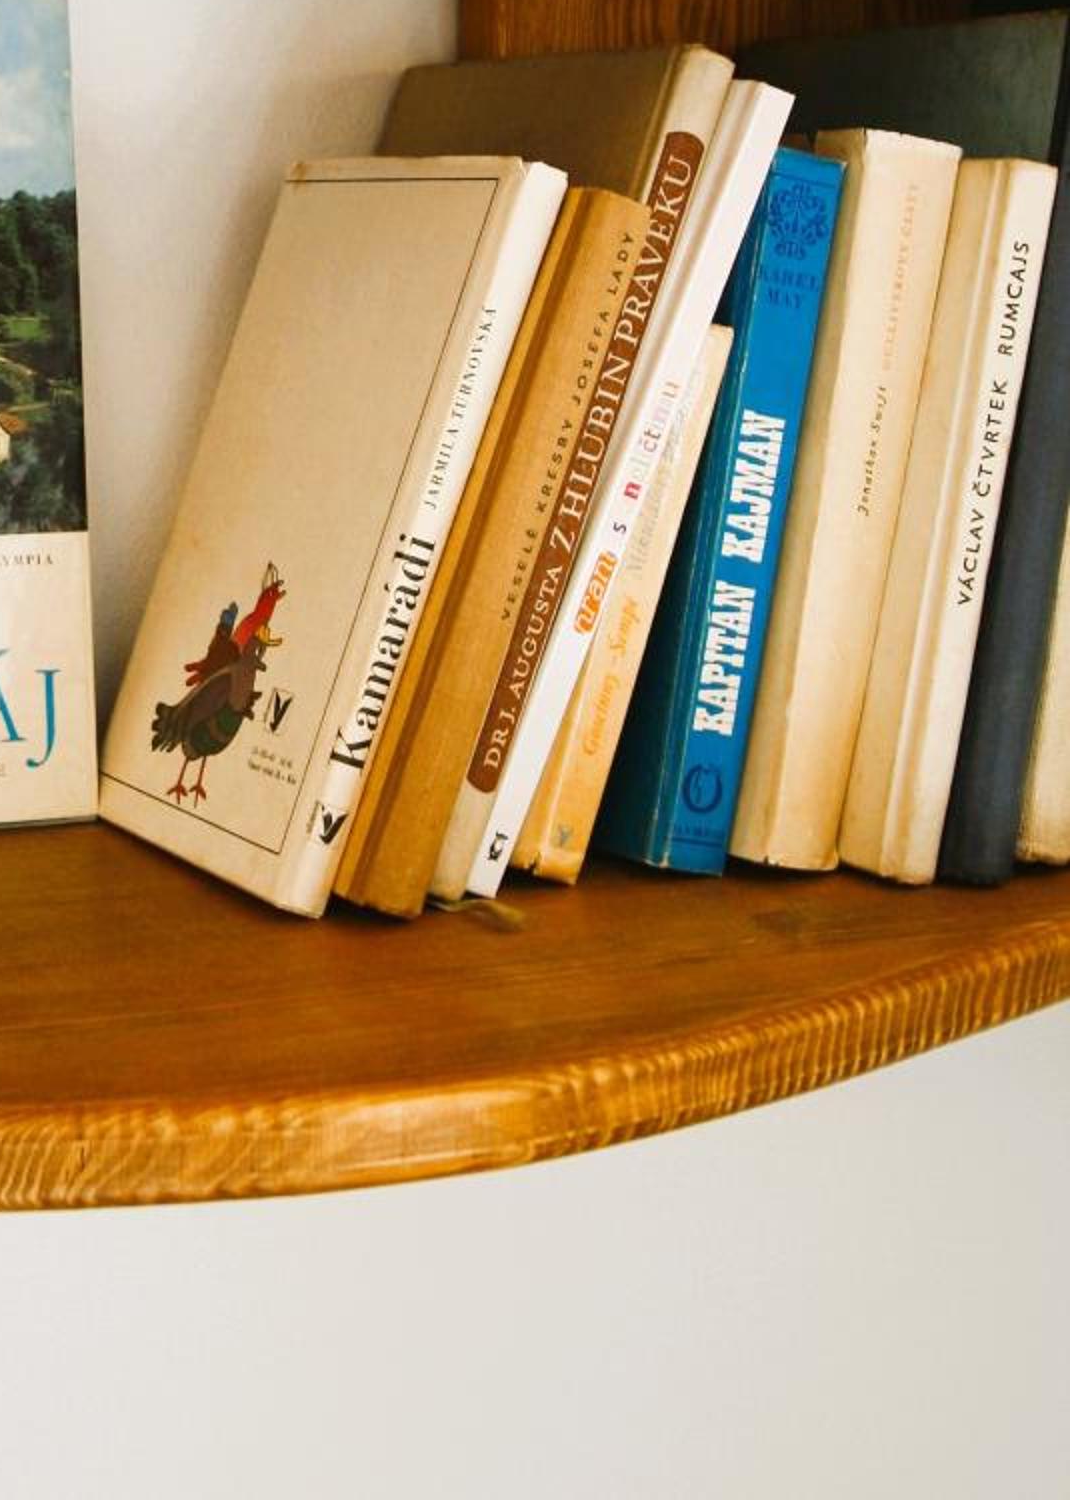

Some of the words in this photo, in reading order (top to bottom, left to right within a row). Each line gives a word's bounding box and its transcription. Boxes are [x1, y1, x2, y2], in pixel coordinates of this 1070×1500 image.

[424, 428, 459, 510] JARMILA
[449, 305, 498, 422] TURNOVSKÁ
[536, 418, 573, 513] KRESBY
[571, 310, 610, 406] JOSEFA
[607, 231, 635, 296] LADY
[558, 351, 631, 521] HLUBIN
[958, 509, 985, 605] VÁCLAV
[972, 380, 1008, 497] ČTVRTEK
[998, 241, 1030, 356] RUMCAJS
[549, 526, 575, 555] Z
[612, 521, 627, 534] s
[722, 409, 786, 563] KAJMAN
[330, 532, 437, 774] Kamarádi
[509, 564, 564, 699] AUGUSTA
